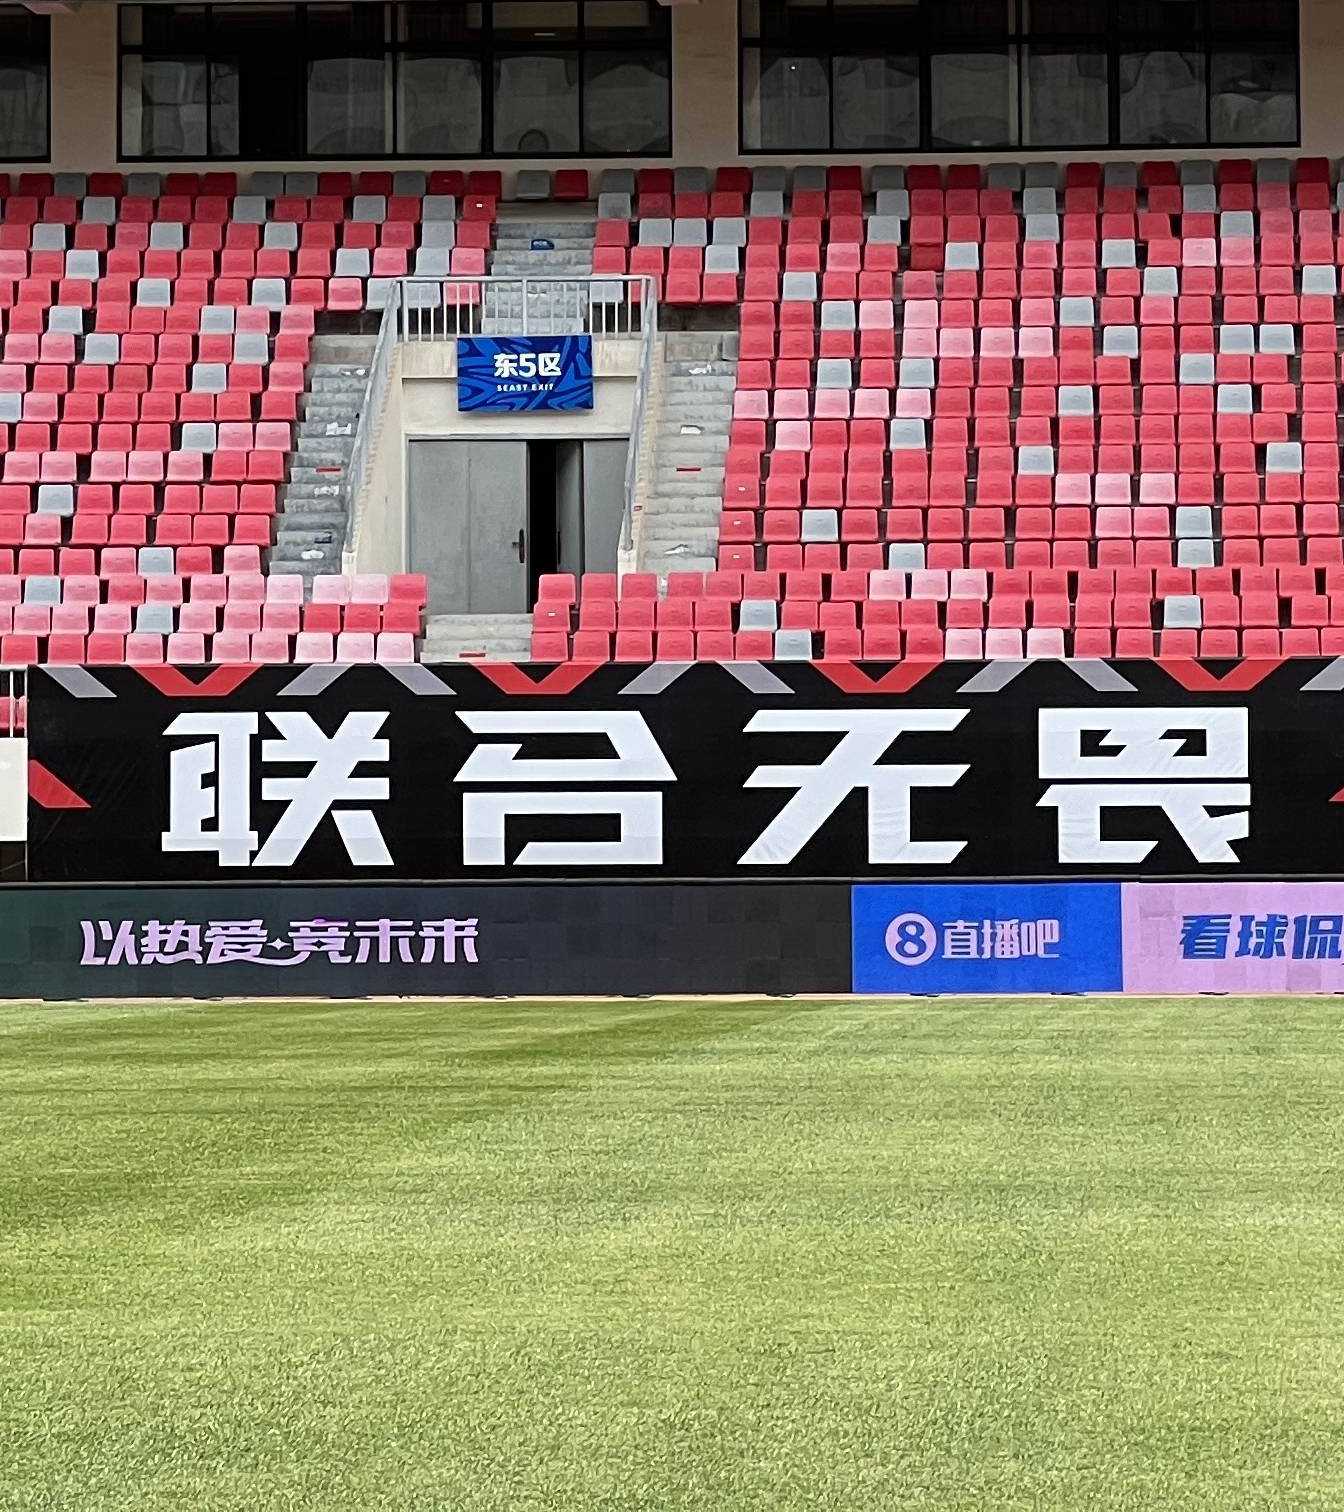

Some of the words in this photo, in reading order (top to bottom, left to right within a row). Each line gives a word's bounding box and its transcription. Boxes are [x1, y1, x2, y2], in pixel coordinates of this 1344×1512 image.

[494, 352, 562, 378] 东5区
[161, 706, 1252, 867] 联合无畏
[941, 918, 1061, 959] 直播吧
